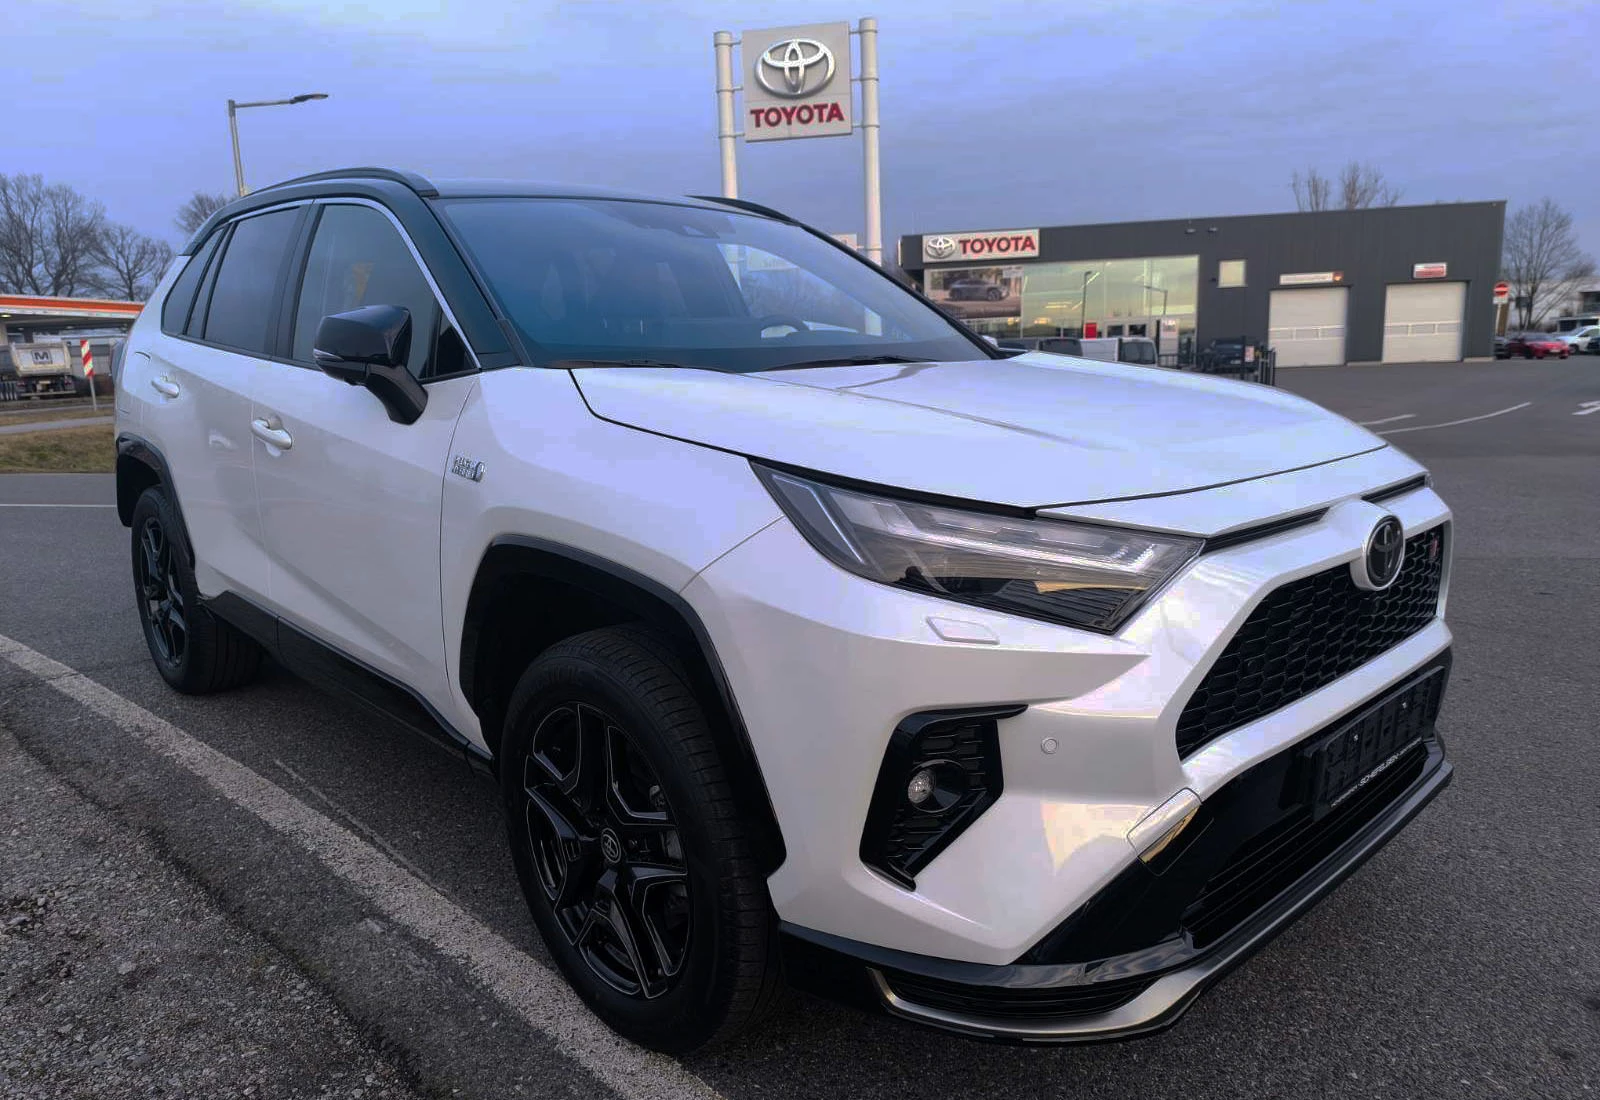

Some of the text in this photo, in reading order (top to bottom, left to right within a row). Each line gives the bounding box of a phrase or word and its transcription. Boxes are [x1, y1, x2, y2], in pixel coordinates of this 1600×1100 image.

[750, 103, 844, 128] TOYOTA
[959, 236, 1036, 254] TOYOTA
[34, 352, 49, 360] M
